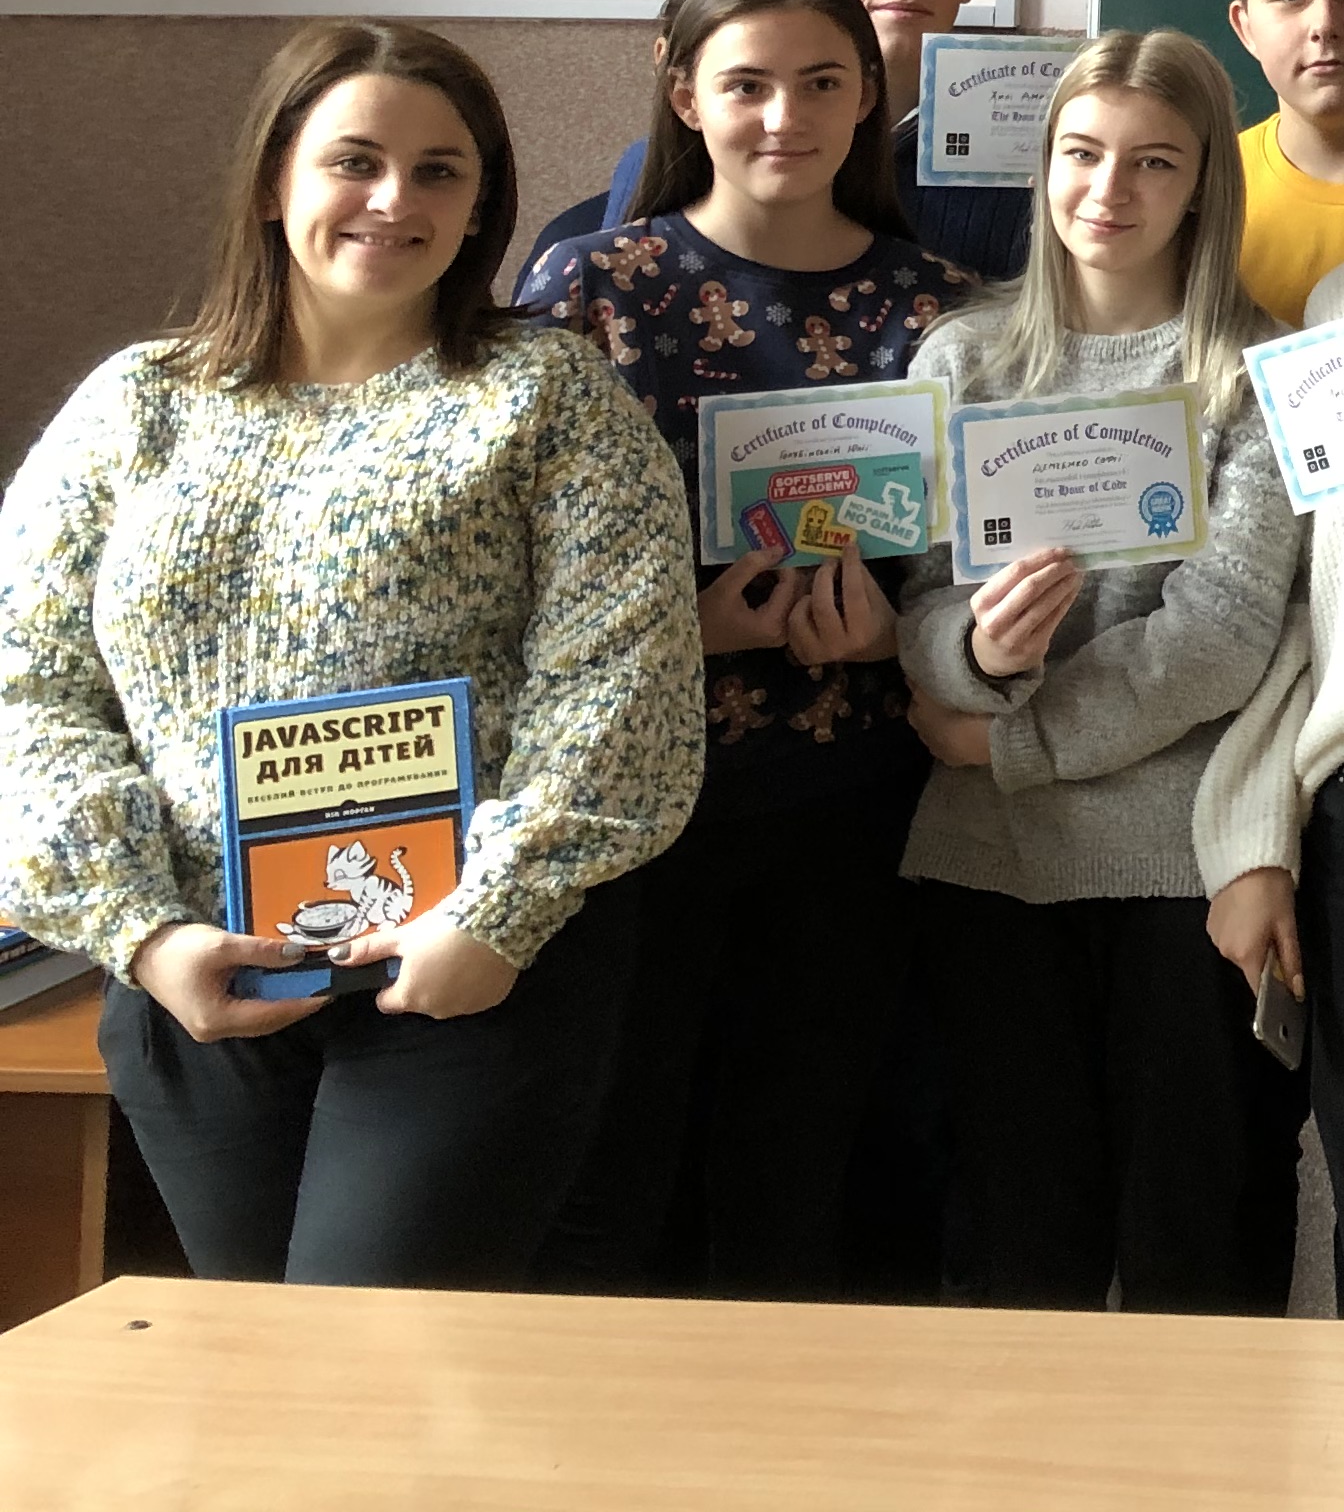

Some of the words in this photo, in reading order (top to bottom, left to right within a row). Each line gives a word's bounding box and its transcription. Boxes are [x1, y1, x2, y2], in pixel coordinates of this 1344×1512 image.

[948, 64, 1017, 98] Certificate
[1021, 61, 1036, 77] of
[1287, 355, 1343, 409] Certificate
[730, 419, 807, 463] Certificate
[811, 413, 828, 431] of
[831, 412, 919, 448] Completion
[980, 430, 1058, 477] Certificate
[1063, 423, 1080, 442] of
[1084, 422, 1174, 459] Completion
[773, 486, 785, 498] IT
[788, 479, 853, 497] ACADEMY
[775, 469, 850, 488] SOFTSERVE
[1033, 486, 1055, 499] The
[1088, 481, 1099, 493] of
[1101, 479, 1128, 491] Code
[848, 500, 864, 512] NO
[843, 508, 868, 525] NO
[870, 518, 915, 541] GAME
[241, 704, 447, 760] JAVASCRIPT
[255, 752, 325, 785] ДЛЯ
[338, 733, 436, 774] ДІТЕЙ
[337, 782, 353, 793] ДО
